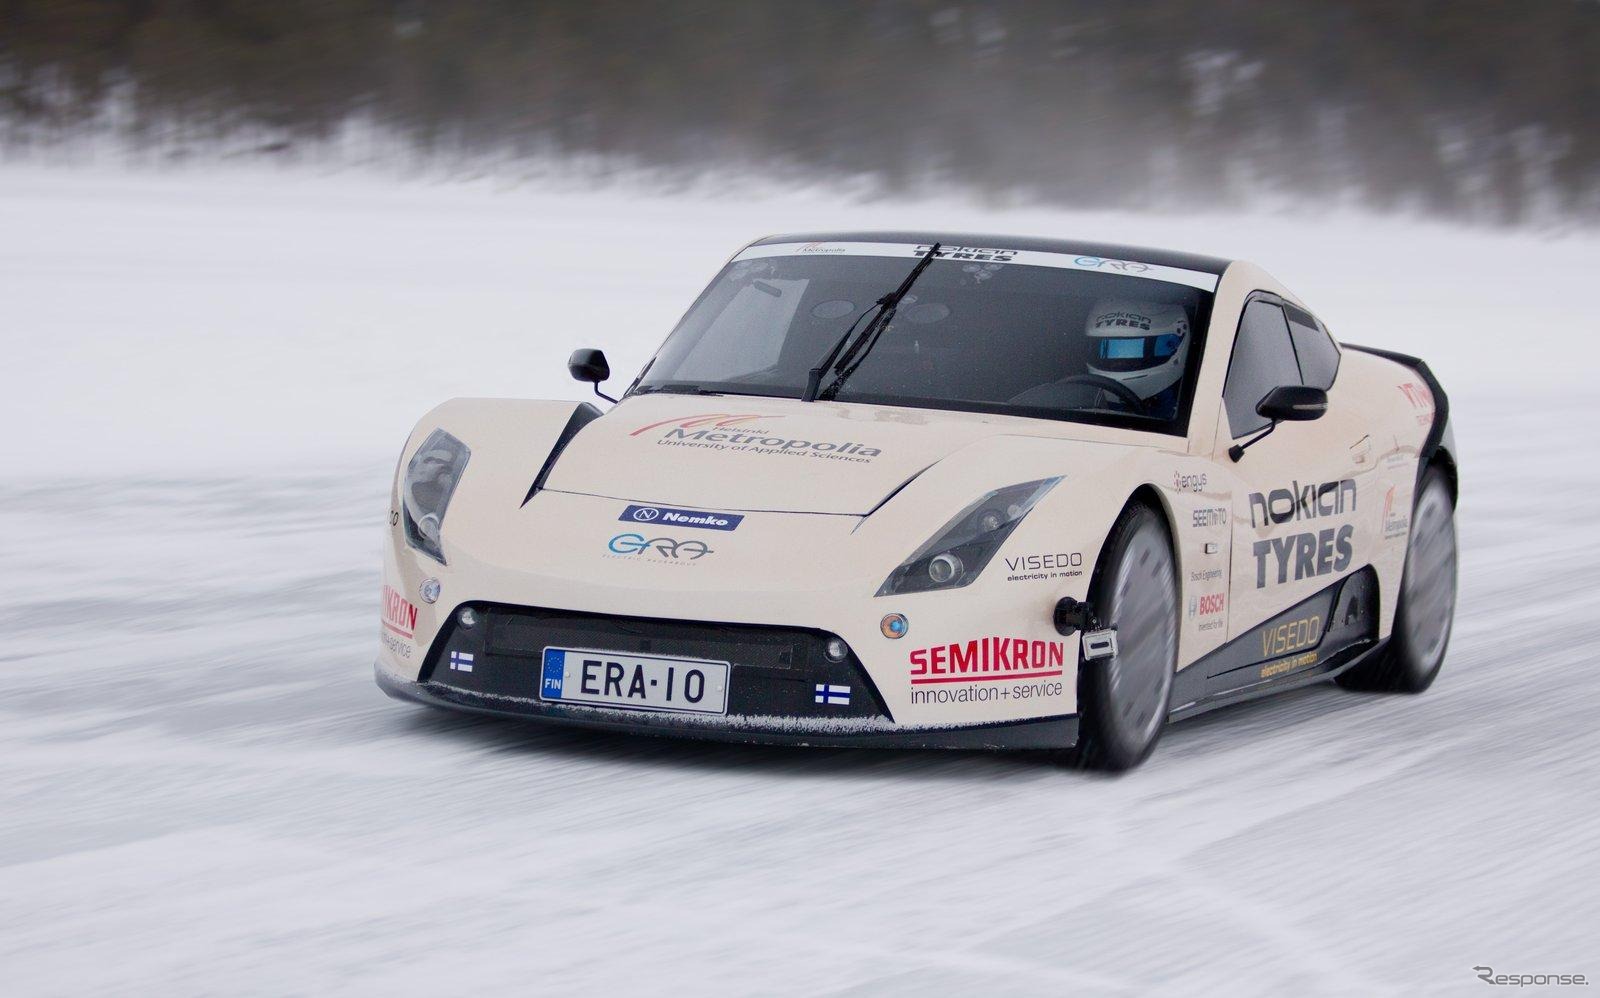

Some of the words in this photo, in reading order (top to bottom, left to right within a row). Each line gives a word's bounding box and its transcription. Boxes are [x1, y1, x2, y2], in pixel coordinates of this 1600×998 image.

[914, 250, 1013, 261] TYRES
[1096, 319, 1150, 331] TYRES
[713, 426, 769, 435] Helsinki
[657, 440, 728, 451] University
[748, 446, 807, 457] Applied
[810, 453, 872, 464] Sciences
[664, 428, 882, 457] Metropolia
[1181, 472, 1207, 492] engys
[1248, 479, 1357, 529] nokian
[663, 512, 729, 527] Nemko
[1005, 552, 1082, 571] VISEDO
[1252, 524, 1355, 589] TYRES
[1007, 573, 1048, 582] electricity
[1060, 570, 1083, 578] motion
[1199, 593, 1225, 616] BOSCH
[1263, 615, 1320, 657] VISEDO
[909, 637, 1064, 675] SEMIKRON
[544, 678, 562, 690] FIN
